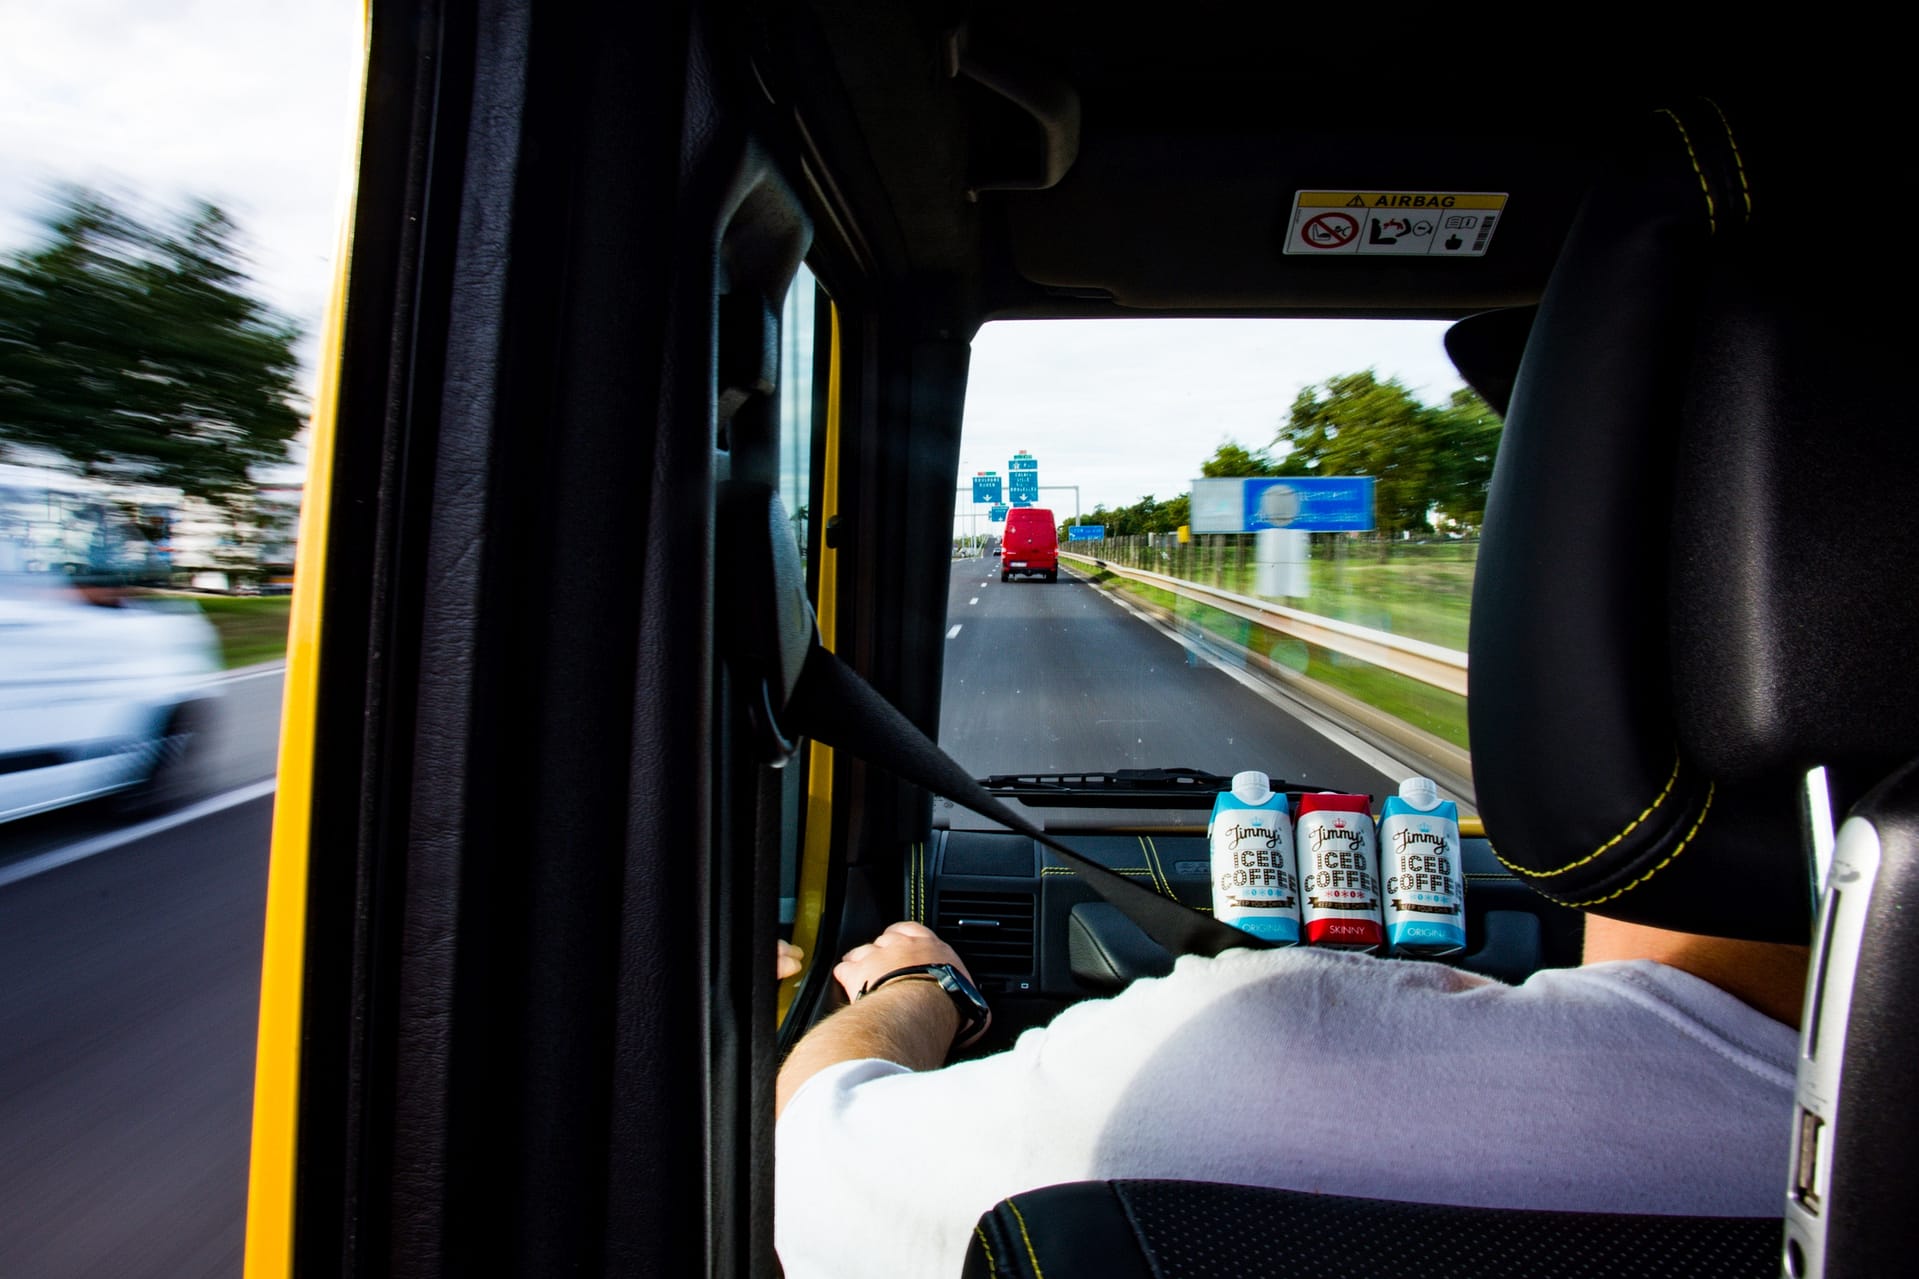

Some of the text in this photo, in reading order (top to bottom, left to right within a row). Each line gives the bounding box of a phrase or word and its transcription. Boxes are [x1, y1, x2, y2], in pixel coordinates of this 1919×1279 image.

[1375, 195, 1456, 208] AIRBAG
[1309, 825, 1366, 852] Jimmy's
[1233, 851, 1284, 868] ICED
[1317, 851, 1367, 870] ICED
[1400, 855, 1451, 876] ICED
[1221, 868, 1297, 893] COFFEE
[1304, 870, 1379, 896] COFFEE
[1329, 925, 1365, 935] SKINNY
[1407, 927, 1452, 938] ORIGIN
